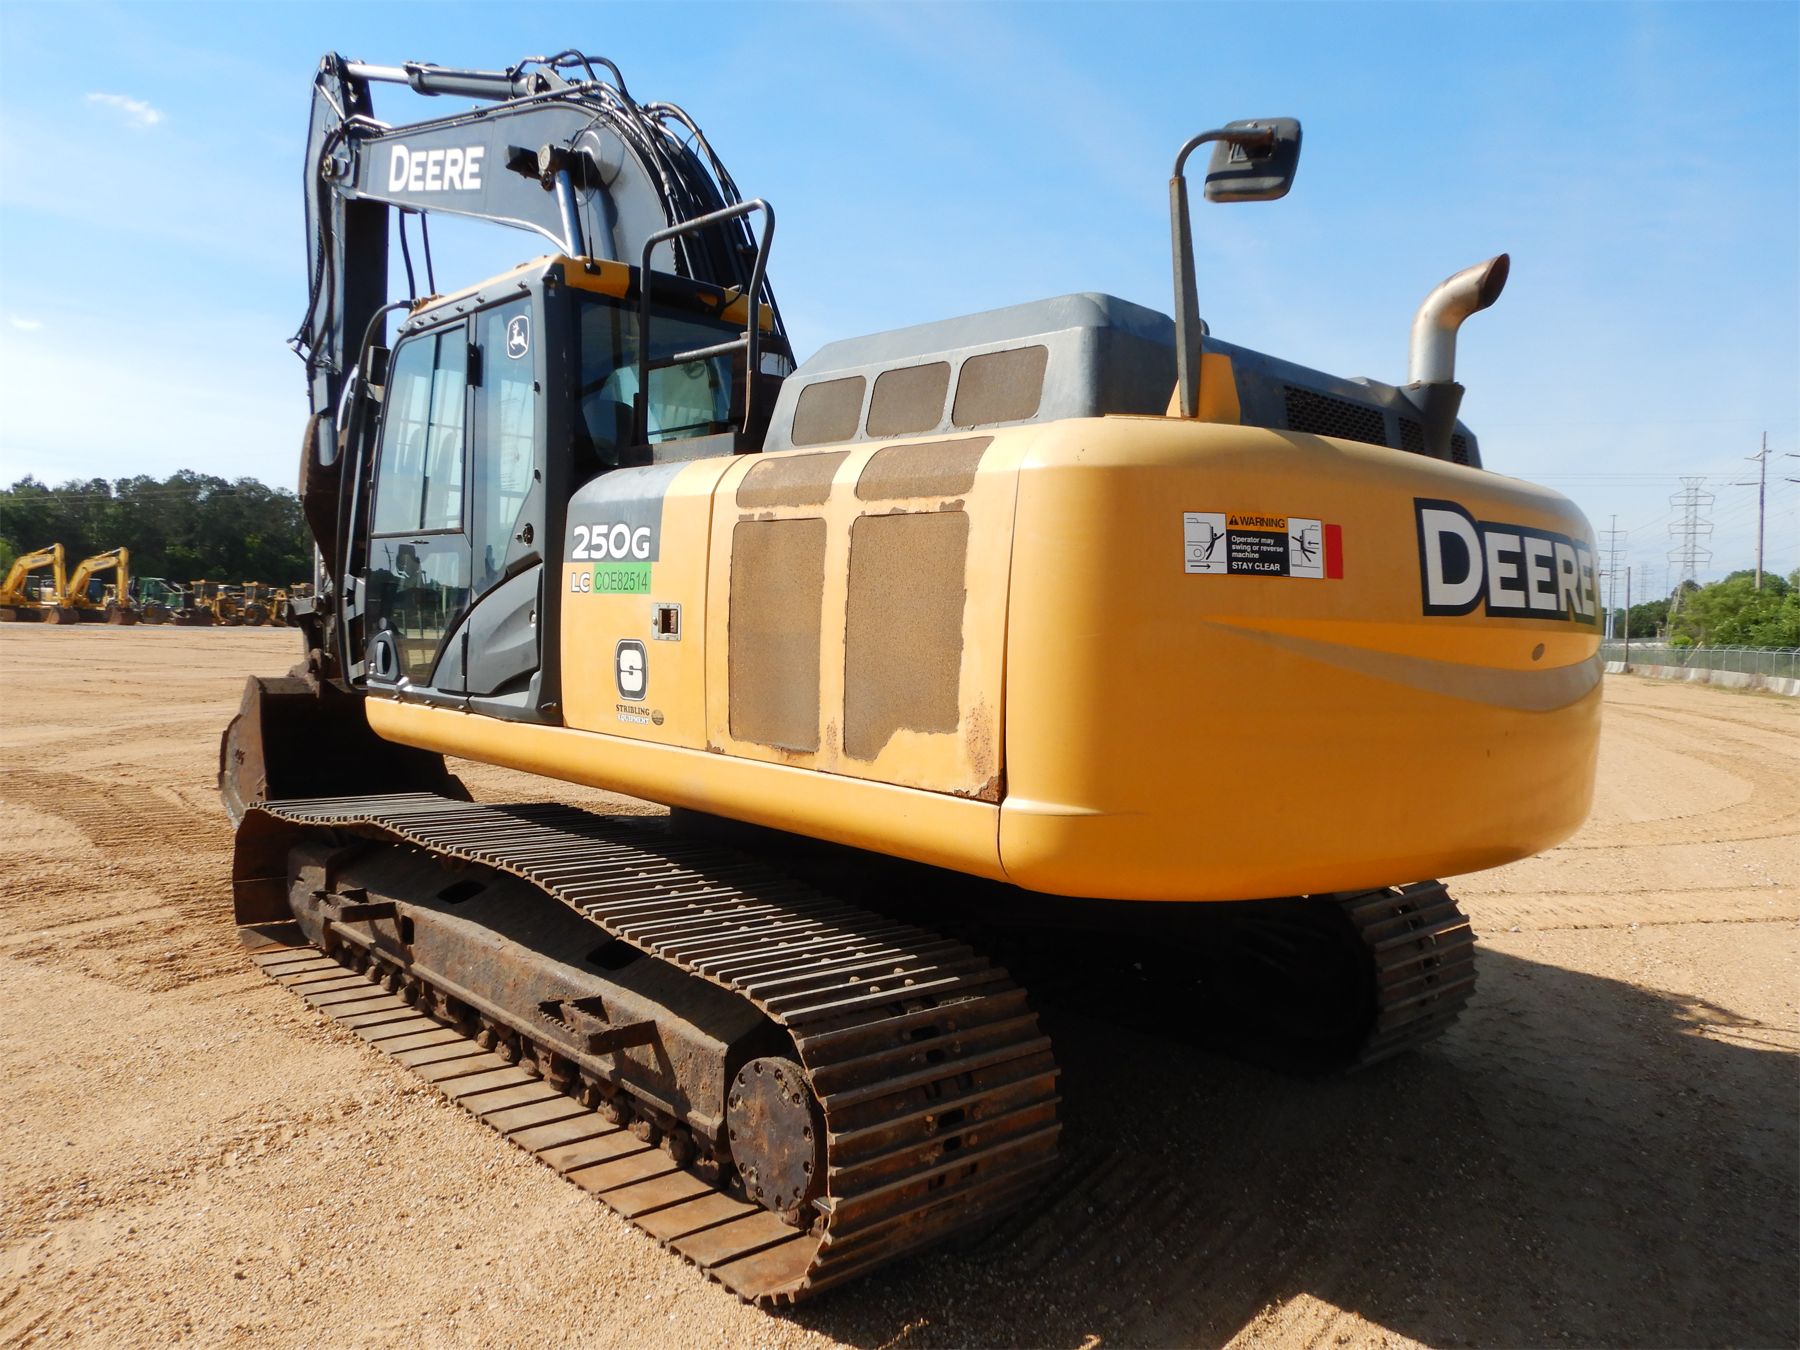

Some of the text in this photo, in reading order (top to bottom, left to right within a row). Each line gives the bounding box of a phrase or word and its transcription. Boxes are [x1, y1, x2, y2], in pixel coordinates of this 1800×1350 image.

[388, 144, 485, 192] DEERE
[1239, 516, 1285, 528] WARNING
[572, 523, 651, 559] 250G
[1231, 535, 1260, 543] Operator
[1231, 544, 1251, 552] swing
[1232, 561, 1281, 571] STAY CLEAR
[1419, 504, 1596, 618] DEERE
[571, 572, 591, 593] LC
[615, 704, 650, 716] STRIBLING
